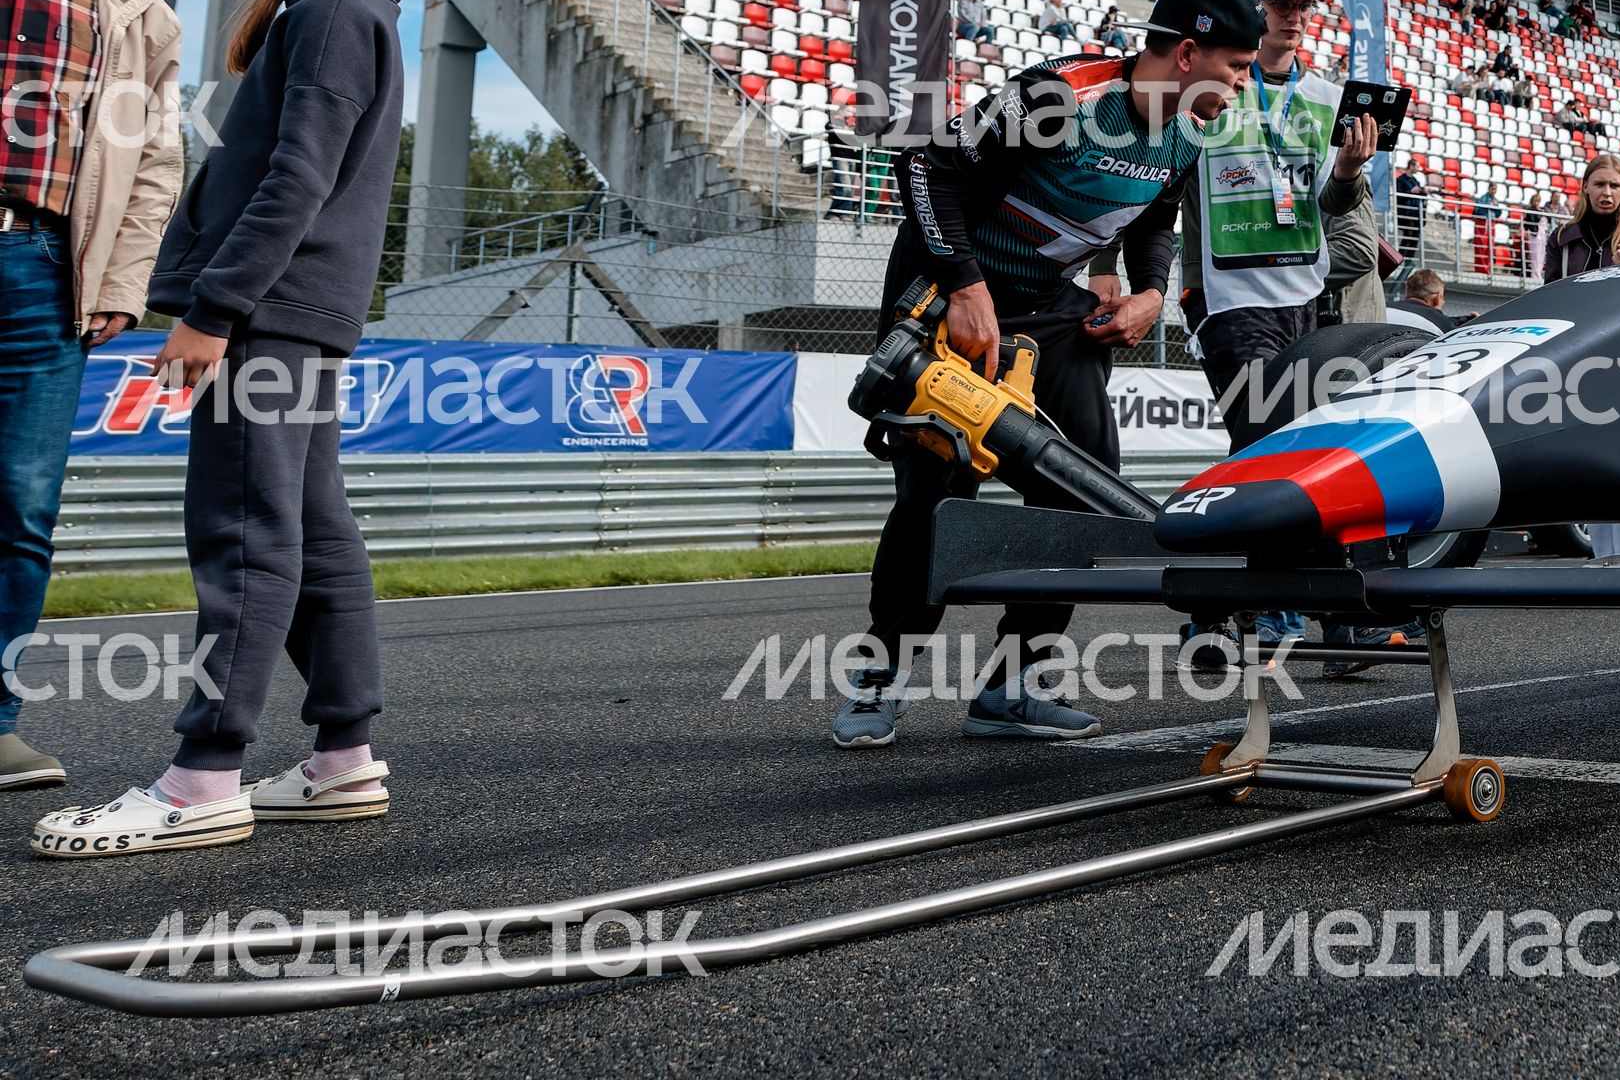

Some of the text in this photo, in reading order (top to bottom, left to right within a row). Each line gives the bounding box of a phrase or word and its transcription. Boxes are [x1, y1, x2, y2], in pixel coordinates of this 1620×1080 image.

[1076, 150, 1171, 183] FORMULA
[1226, 169, 1251, 180] РСКГ
[1221, 221, 1272, 233] РСКГ.рф
[1276, 255, 1304, 265] YOKOHAMA
[1366, 348, 1490, 385] 33
[562, 437, 648, 446] ENGINEERING
[41, 833, 131, 852] crocs
